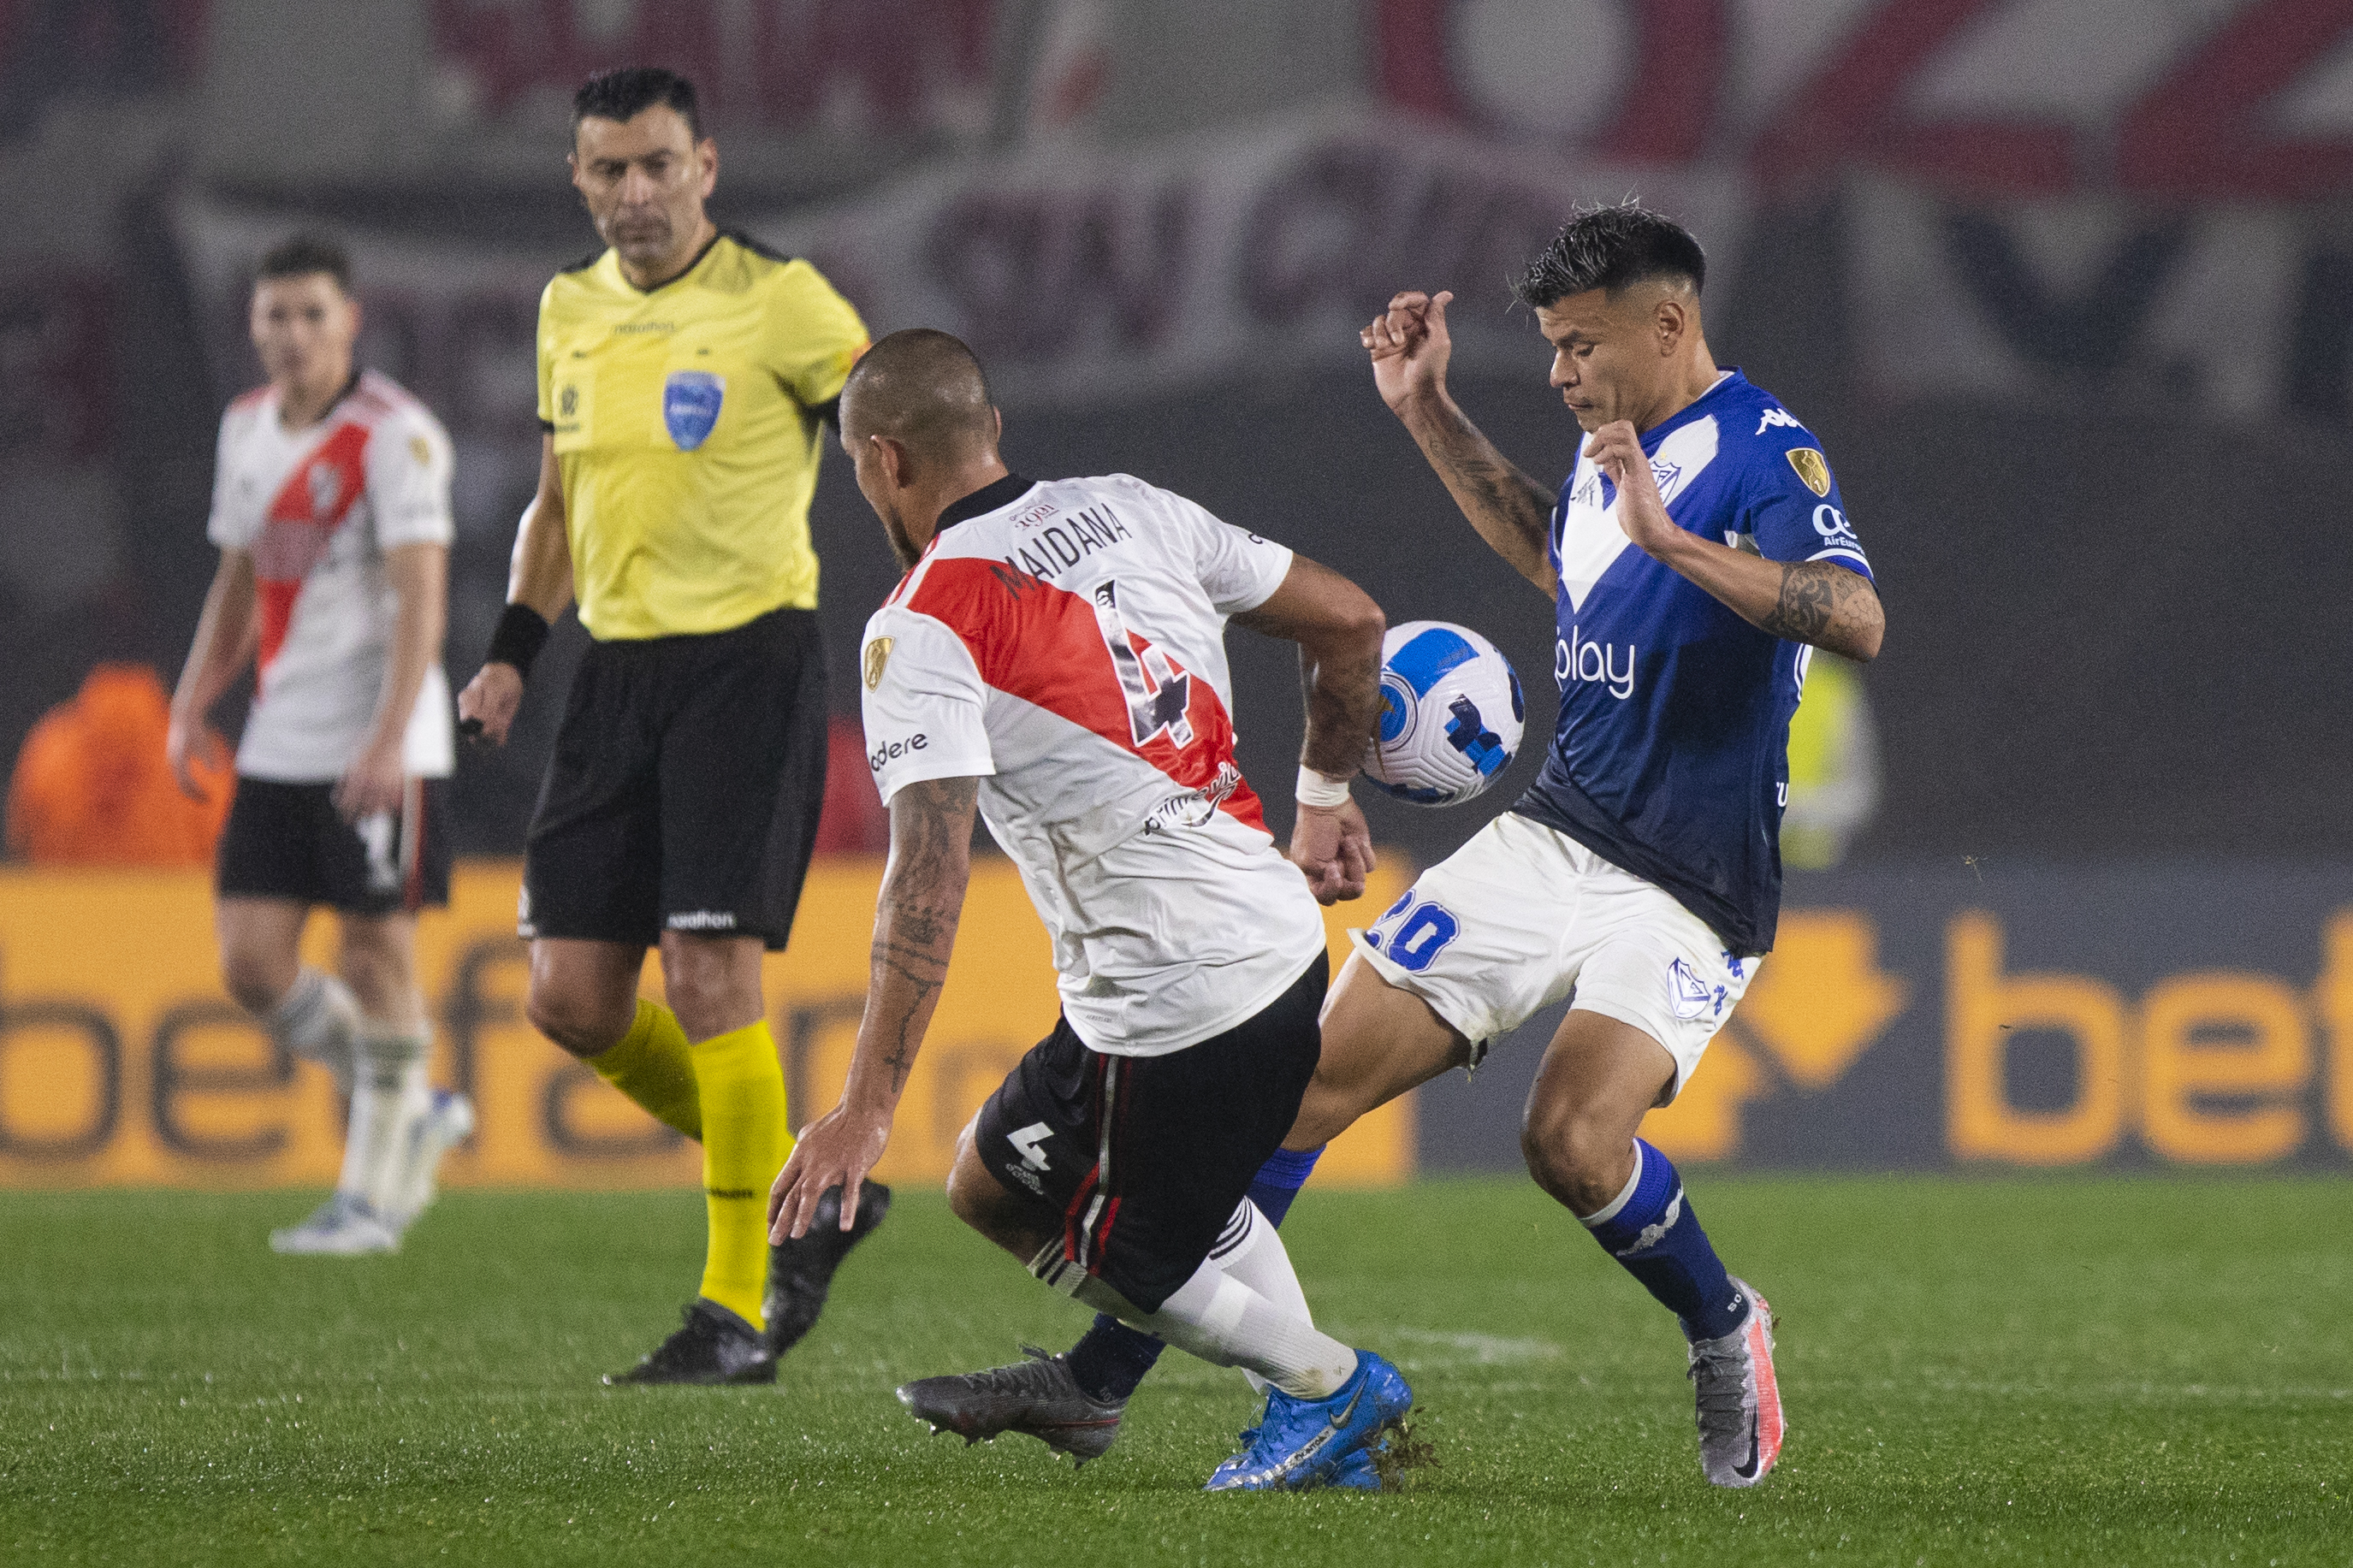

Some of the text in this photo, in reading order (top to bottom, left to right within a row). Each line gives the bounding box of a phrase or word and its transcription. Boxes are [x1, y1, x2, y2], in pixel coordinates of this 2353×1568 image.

[989, 503, 1133, 601] MAIDANA
[1093, 578, 1194, 751] 4
[1006, 1121, 1054, 1171] 4
